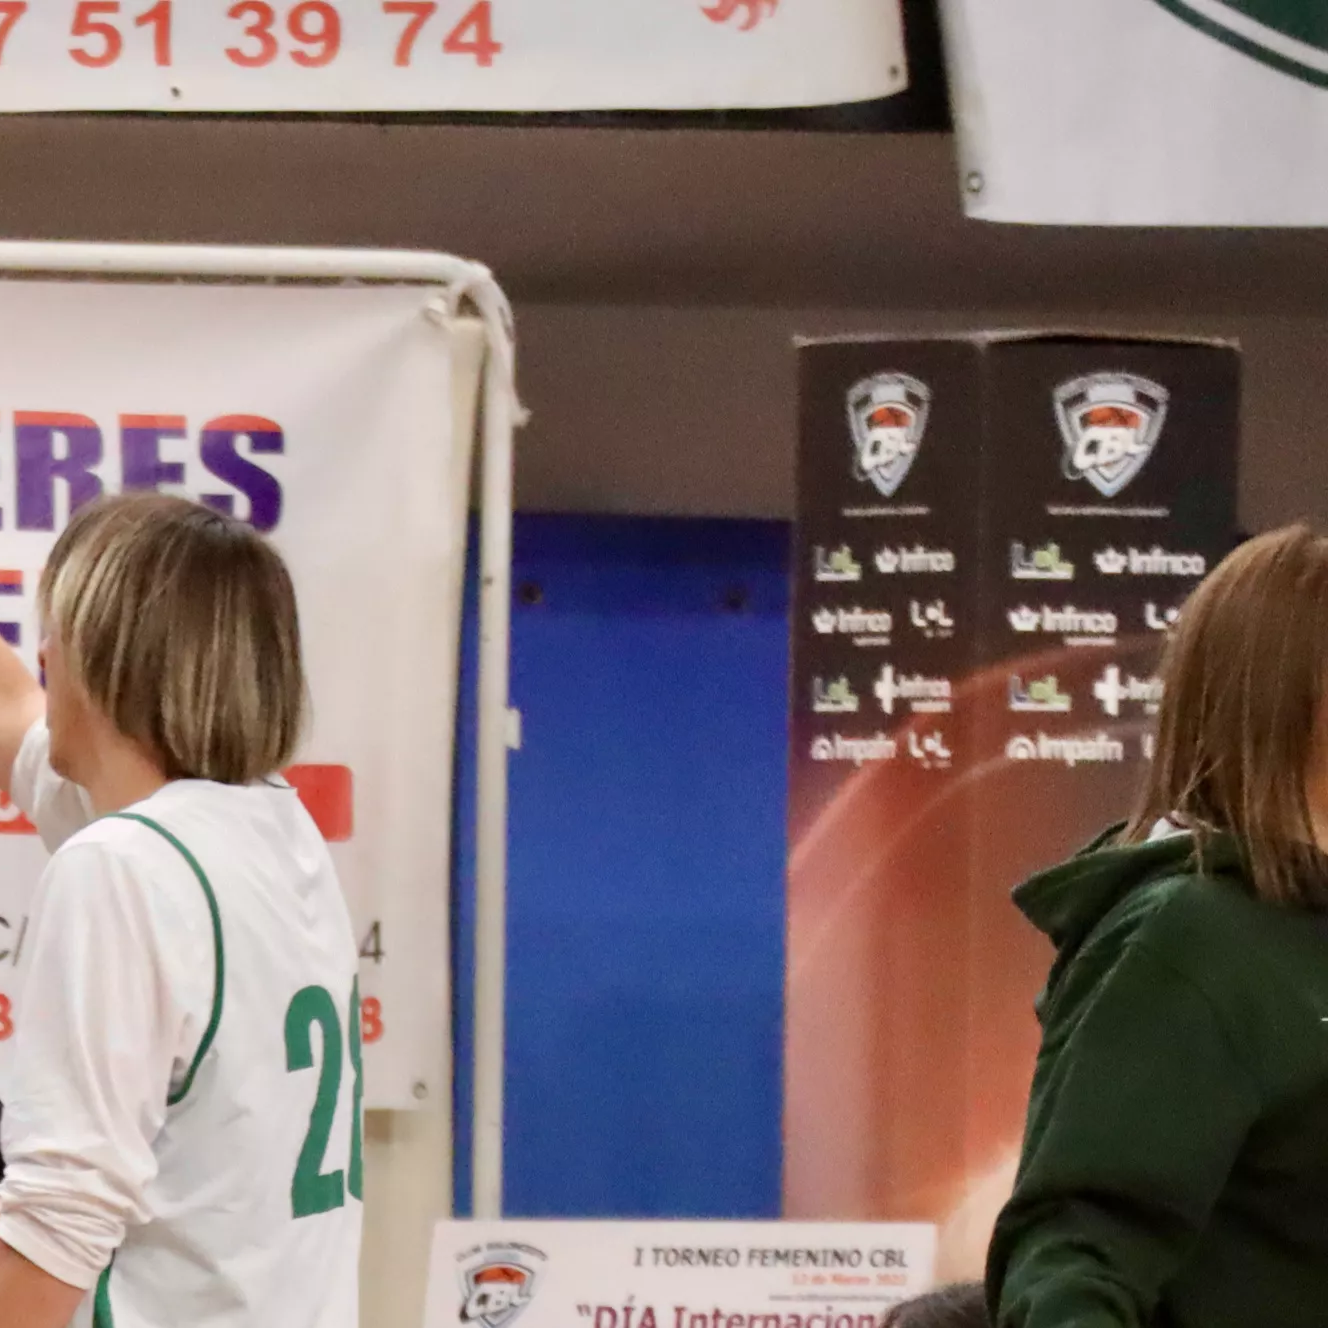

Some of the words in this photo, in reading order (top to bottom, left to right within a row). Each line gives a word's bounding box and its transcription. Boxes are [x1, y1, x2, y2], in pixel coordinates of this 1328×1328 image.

[66, 0, 173, 67] 51
[224, 0, 341, 67] 39
[382, 0, 503, 67] 74
[284, 973, 364, 1220] 2
[633, 1248, 645, 1267] I
[652, 1248, 740, 1268] TORNEO
[747, 1248, 862, 1268] FEMENINO
[870, 1248, 908, 1268] CBL
